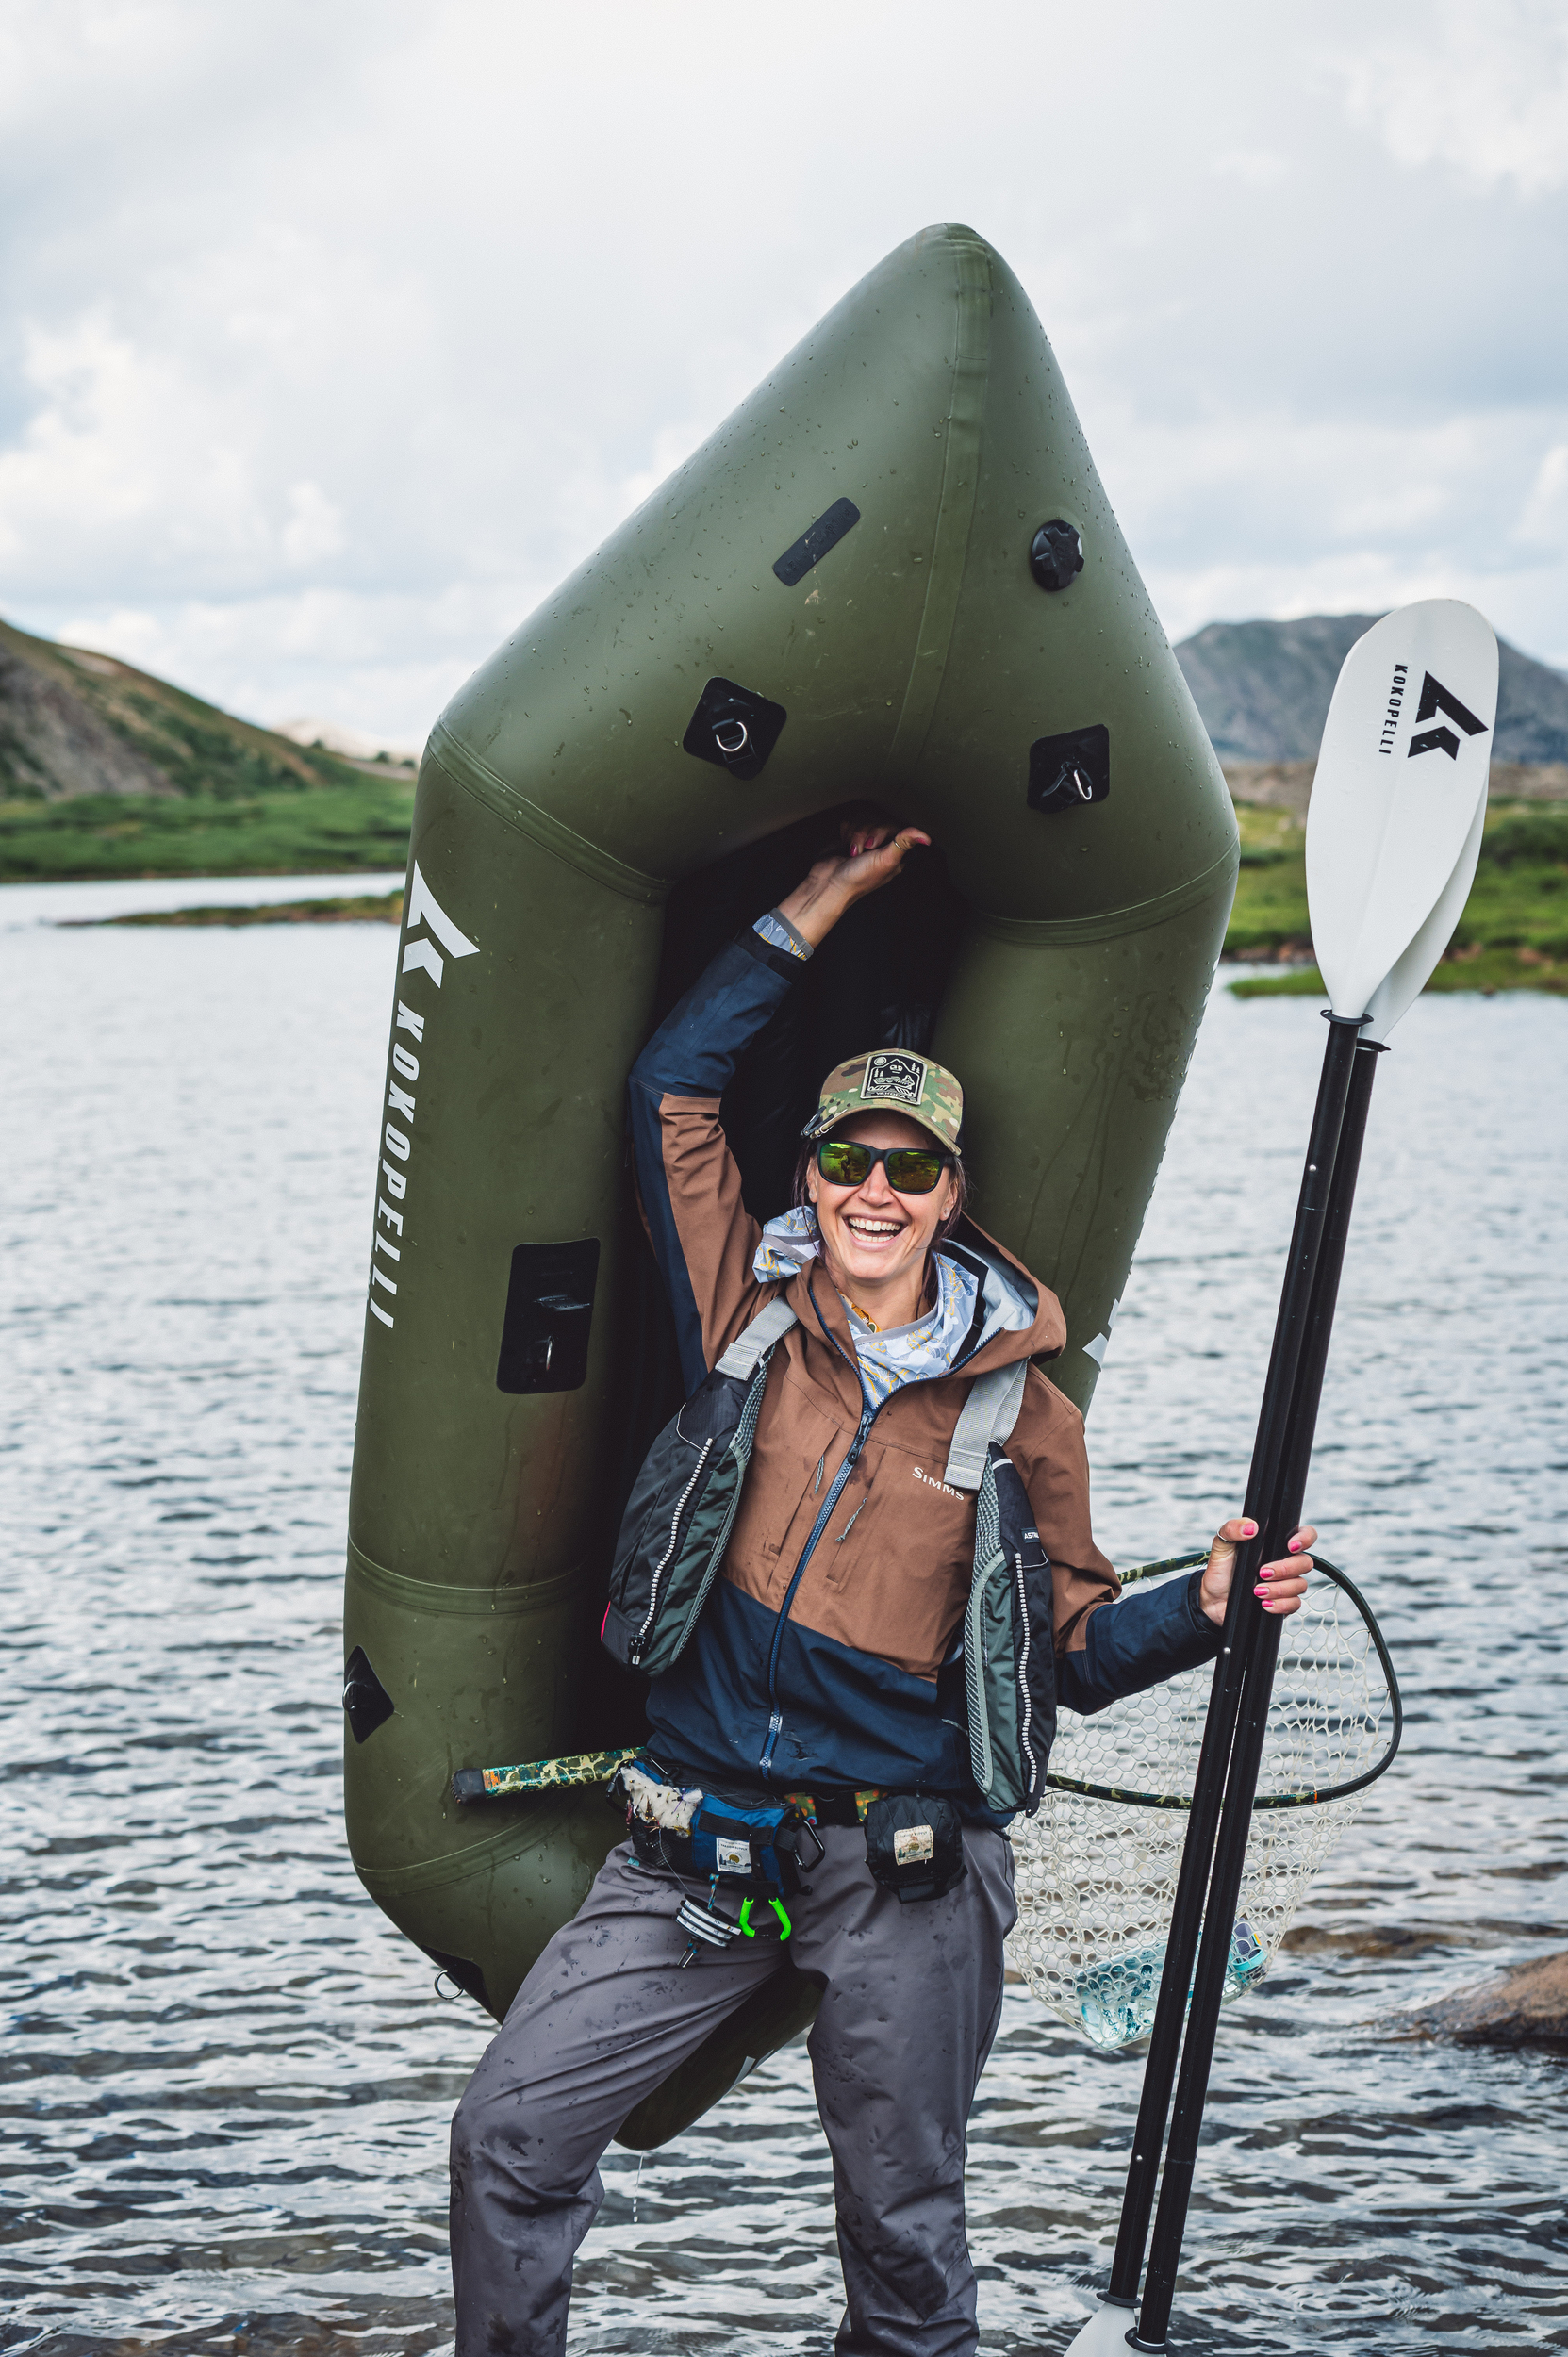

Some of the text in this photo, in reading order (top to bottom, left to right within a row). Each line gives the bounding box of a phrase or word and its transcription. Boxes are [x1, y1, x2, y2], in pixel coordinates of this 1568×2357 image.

[1378, 664, 1409, 755] KOKOPELLI
[370, 999, 425, 1329] KOKOPELLI
[912, 1466, 965, 1501] SIMMS
